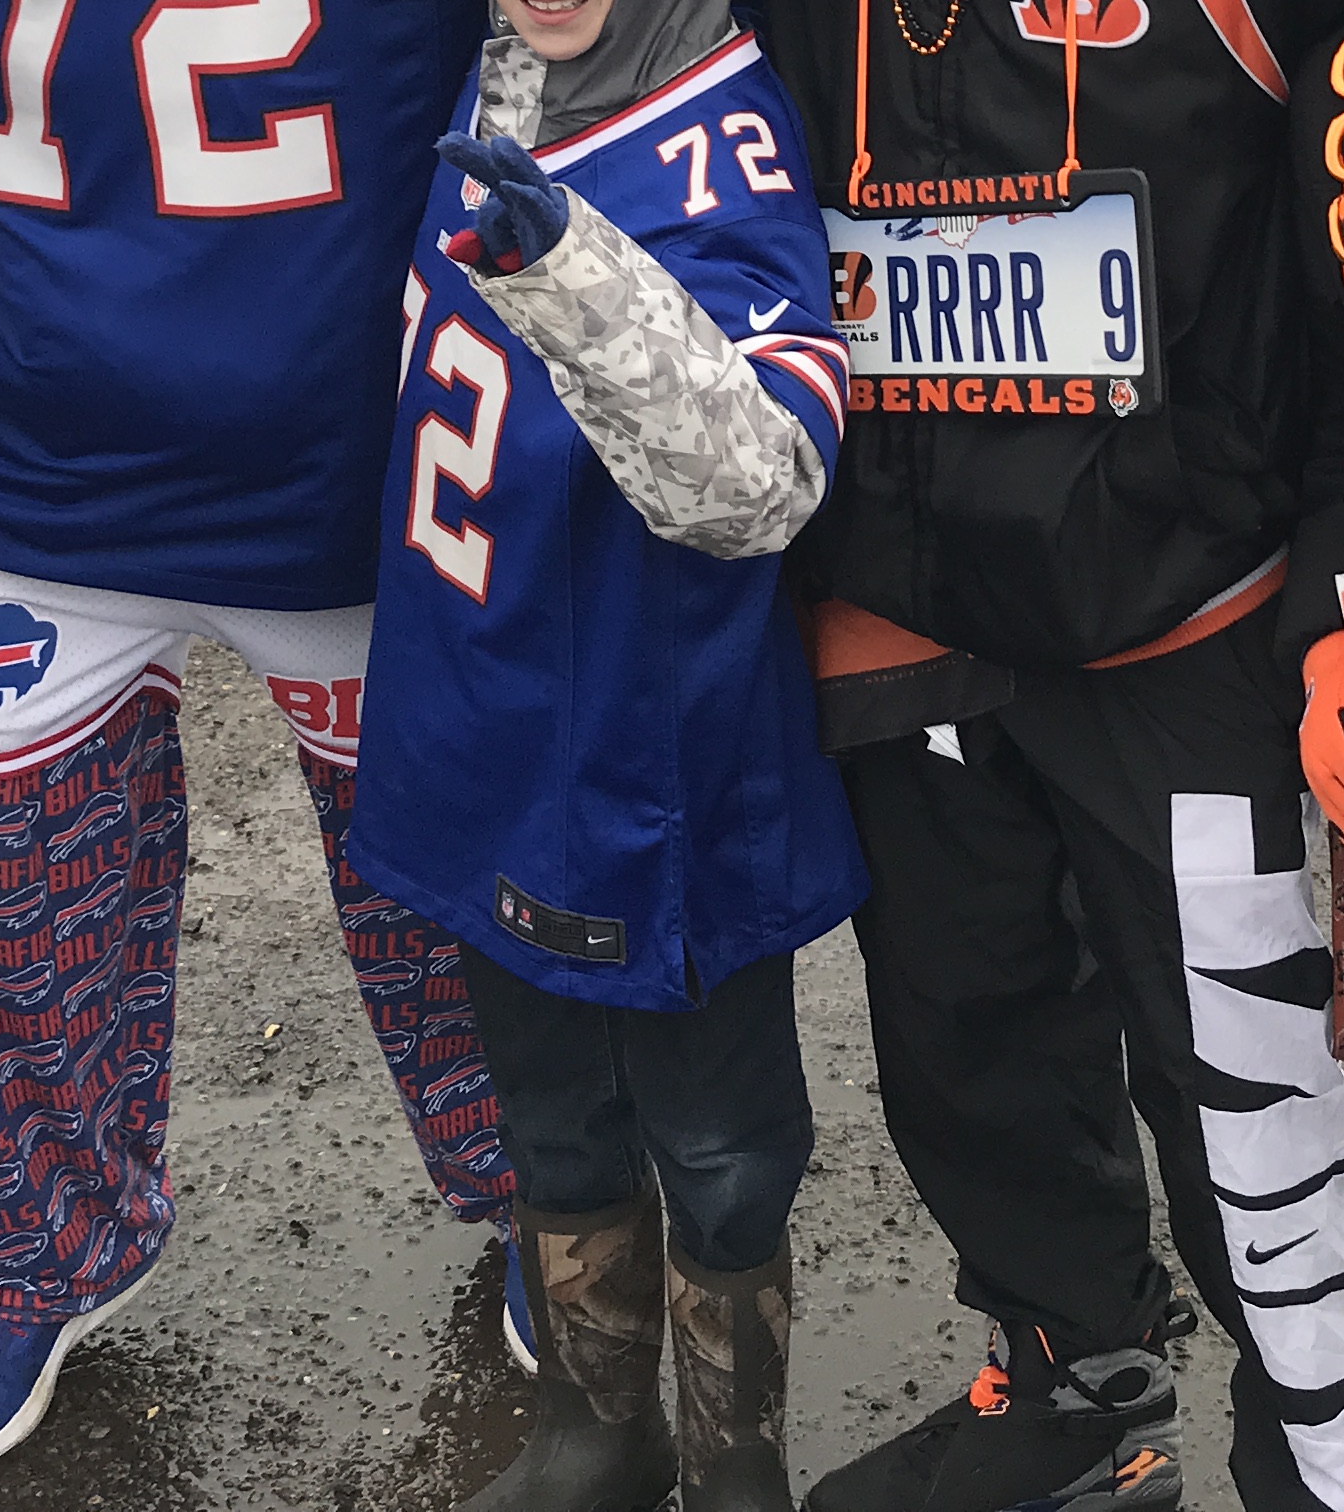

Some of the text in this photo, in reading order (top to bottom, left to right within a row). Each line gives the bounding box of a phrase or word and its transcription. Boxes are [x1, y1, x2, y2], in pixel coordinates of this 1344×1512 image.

[657, 112, 796, 219] 72
[861, 173, 1055, 210] CINCINNATI
[886, 248, 1137, 364] RRRR 9
[847, 377, 1097, 415] BENGALS
[47, 835, 132, 895] BILLS
